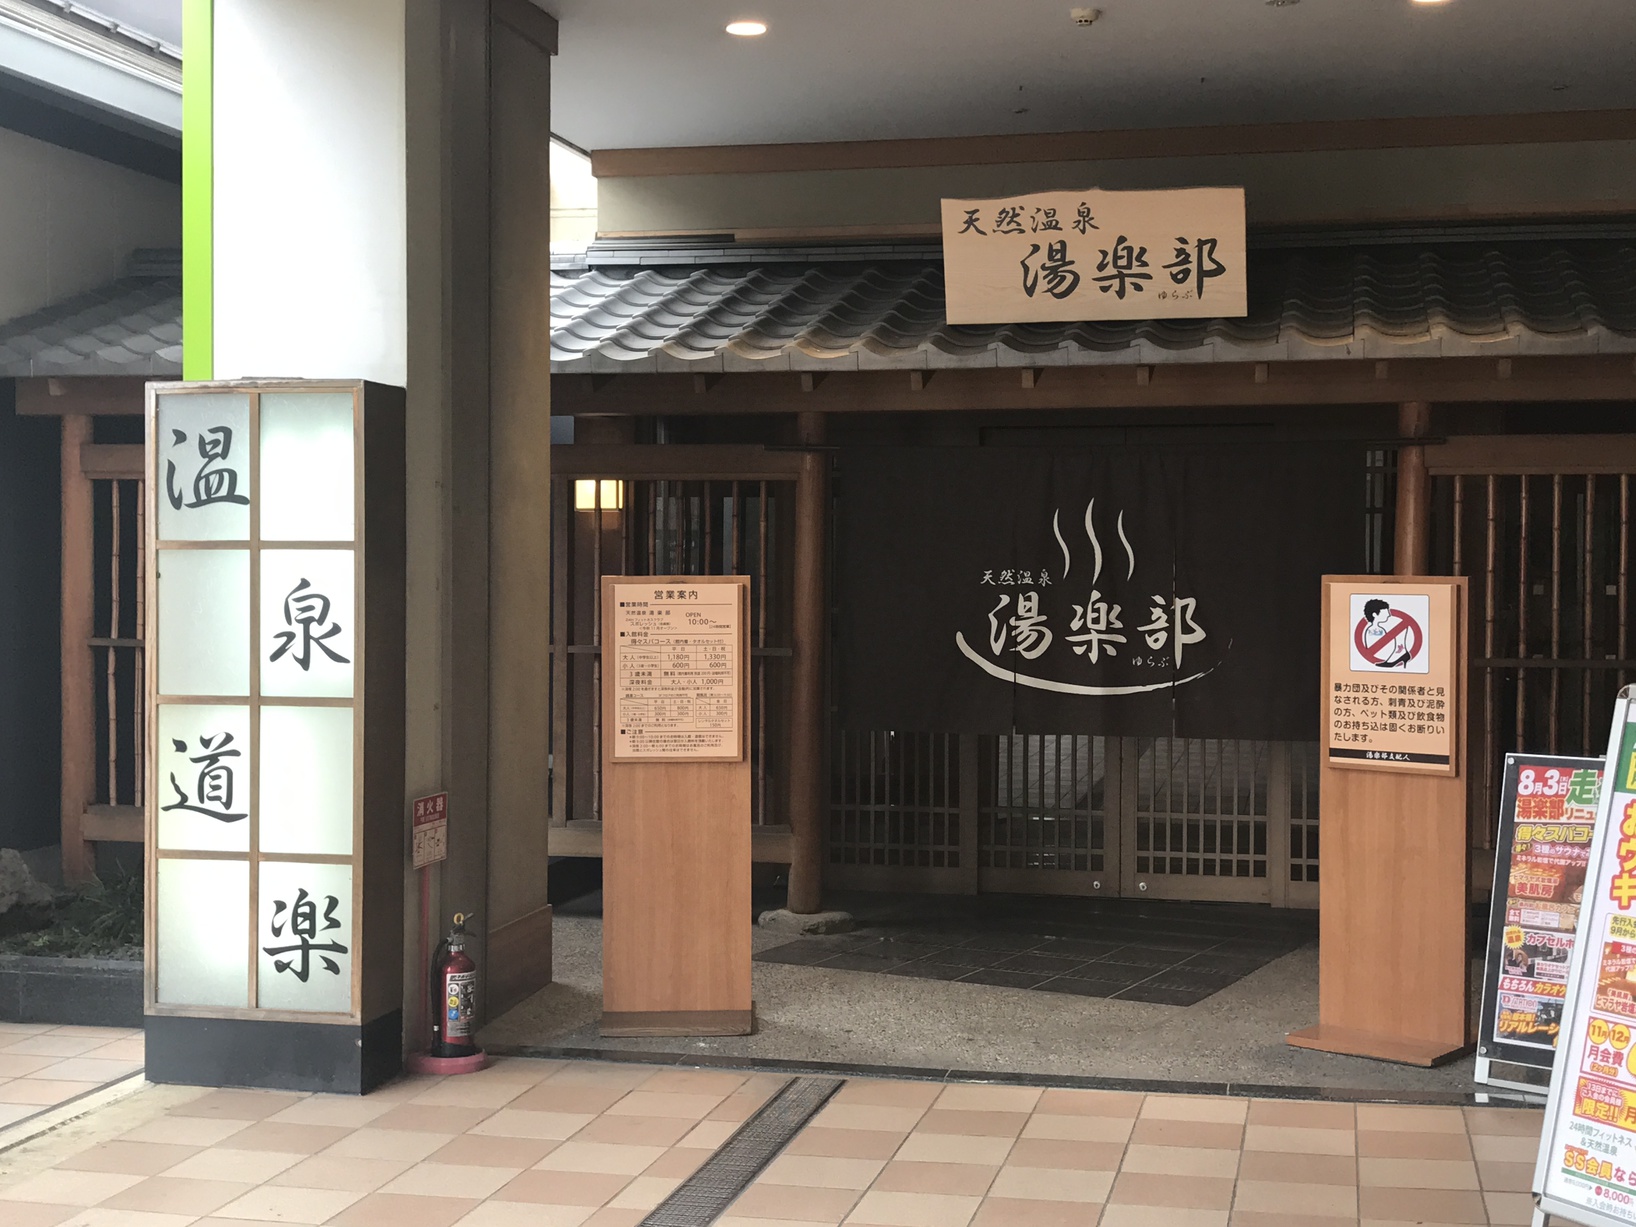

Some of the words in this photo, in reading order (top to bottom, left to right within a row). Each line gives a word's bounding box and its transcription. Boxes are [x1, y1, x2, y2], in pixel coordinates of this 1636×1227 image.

[957, 201, 1100, 236] 天然温泉
[1019, 234, 1227, 300] 湯楽部
[1157, 289, 1193, 301] ゆらぶ
[980, 568, 1053, 587] 天然温泉
[653, 590, 699, 600] 営業案内
[987, 589, 1207, 670] 湯楽部
[1132, 656, 1170, 668] ゆらぶ
[1333, 682, 1446, 697] 暴力団及びその関係者と見
[1333, 694, 1446, 710] なされる方、刺青及び泥酔
[1333, 707, 1446, 723] の方、ペット類及び飲食物
[1333, 719, 1446, 735] のお持ち込は固くお断りい
[1333, 732, 1373, 743] たします。
[416, 796, 444, 817] 消火器
[1515, 797, 1566, 820] 湯楽部
[1587, 1044, 1625, 1068] 月会費
[1568, 1121, 1633, 1148] 24時間フィットネス
[1580, 1137, 1618, 1157] &天然温泉
